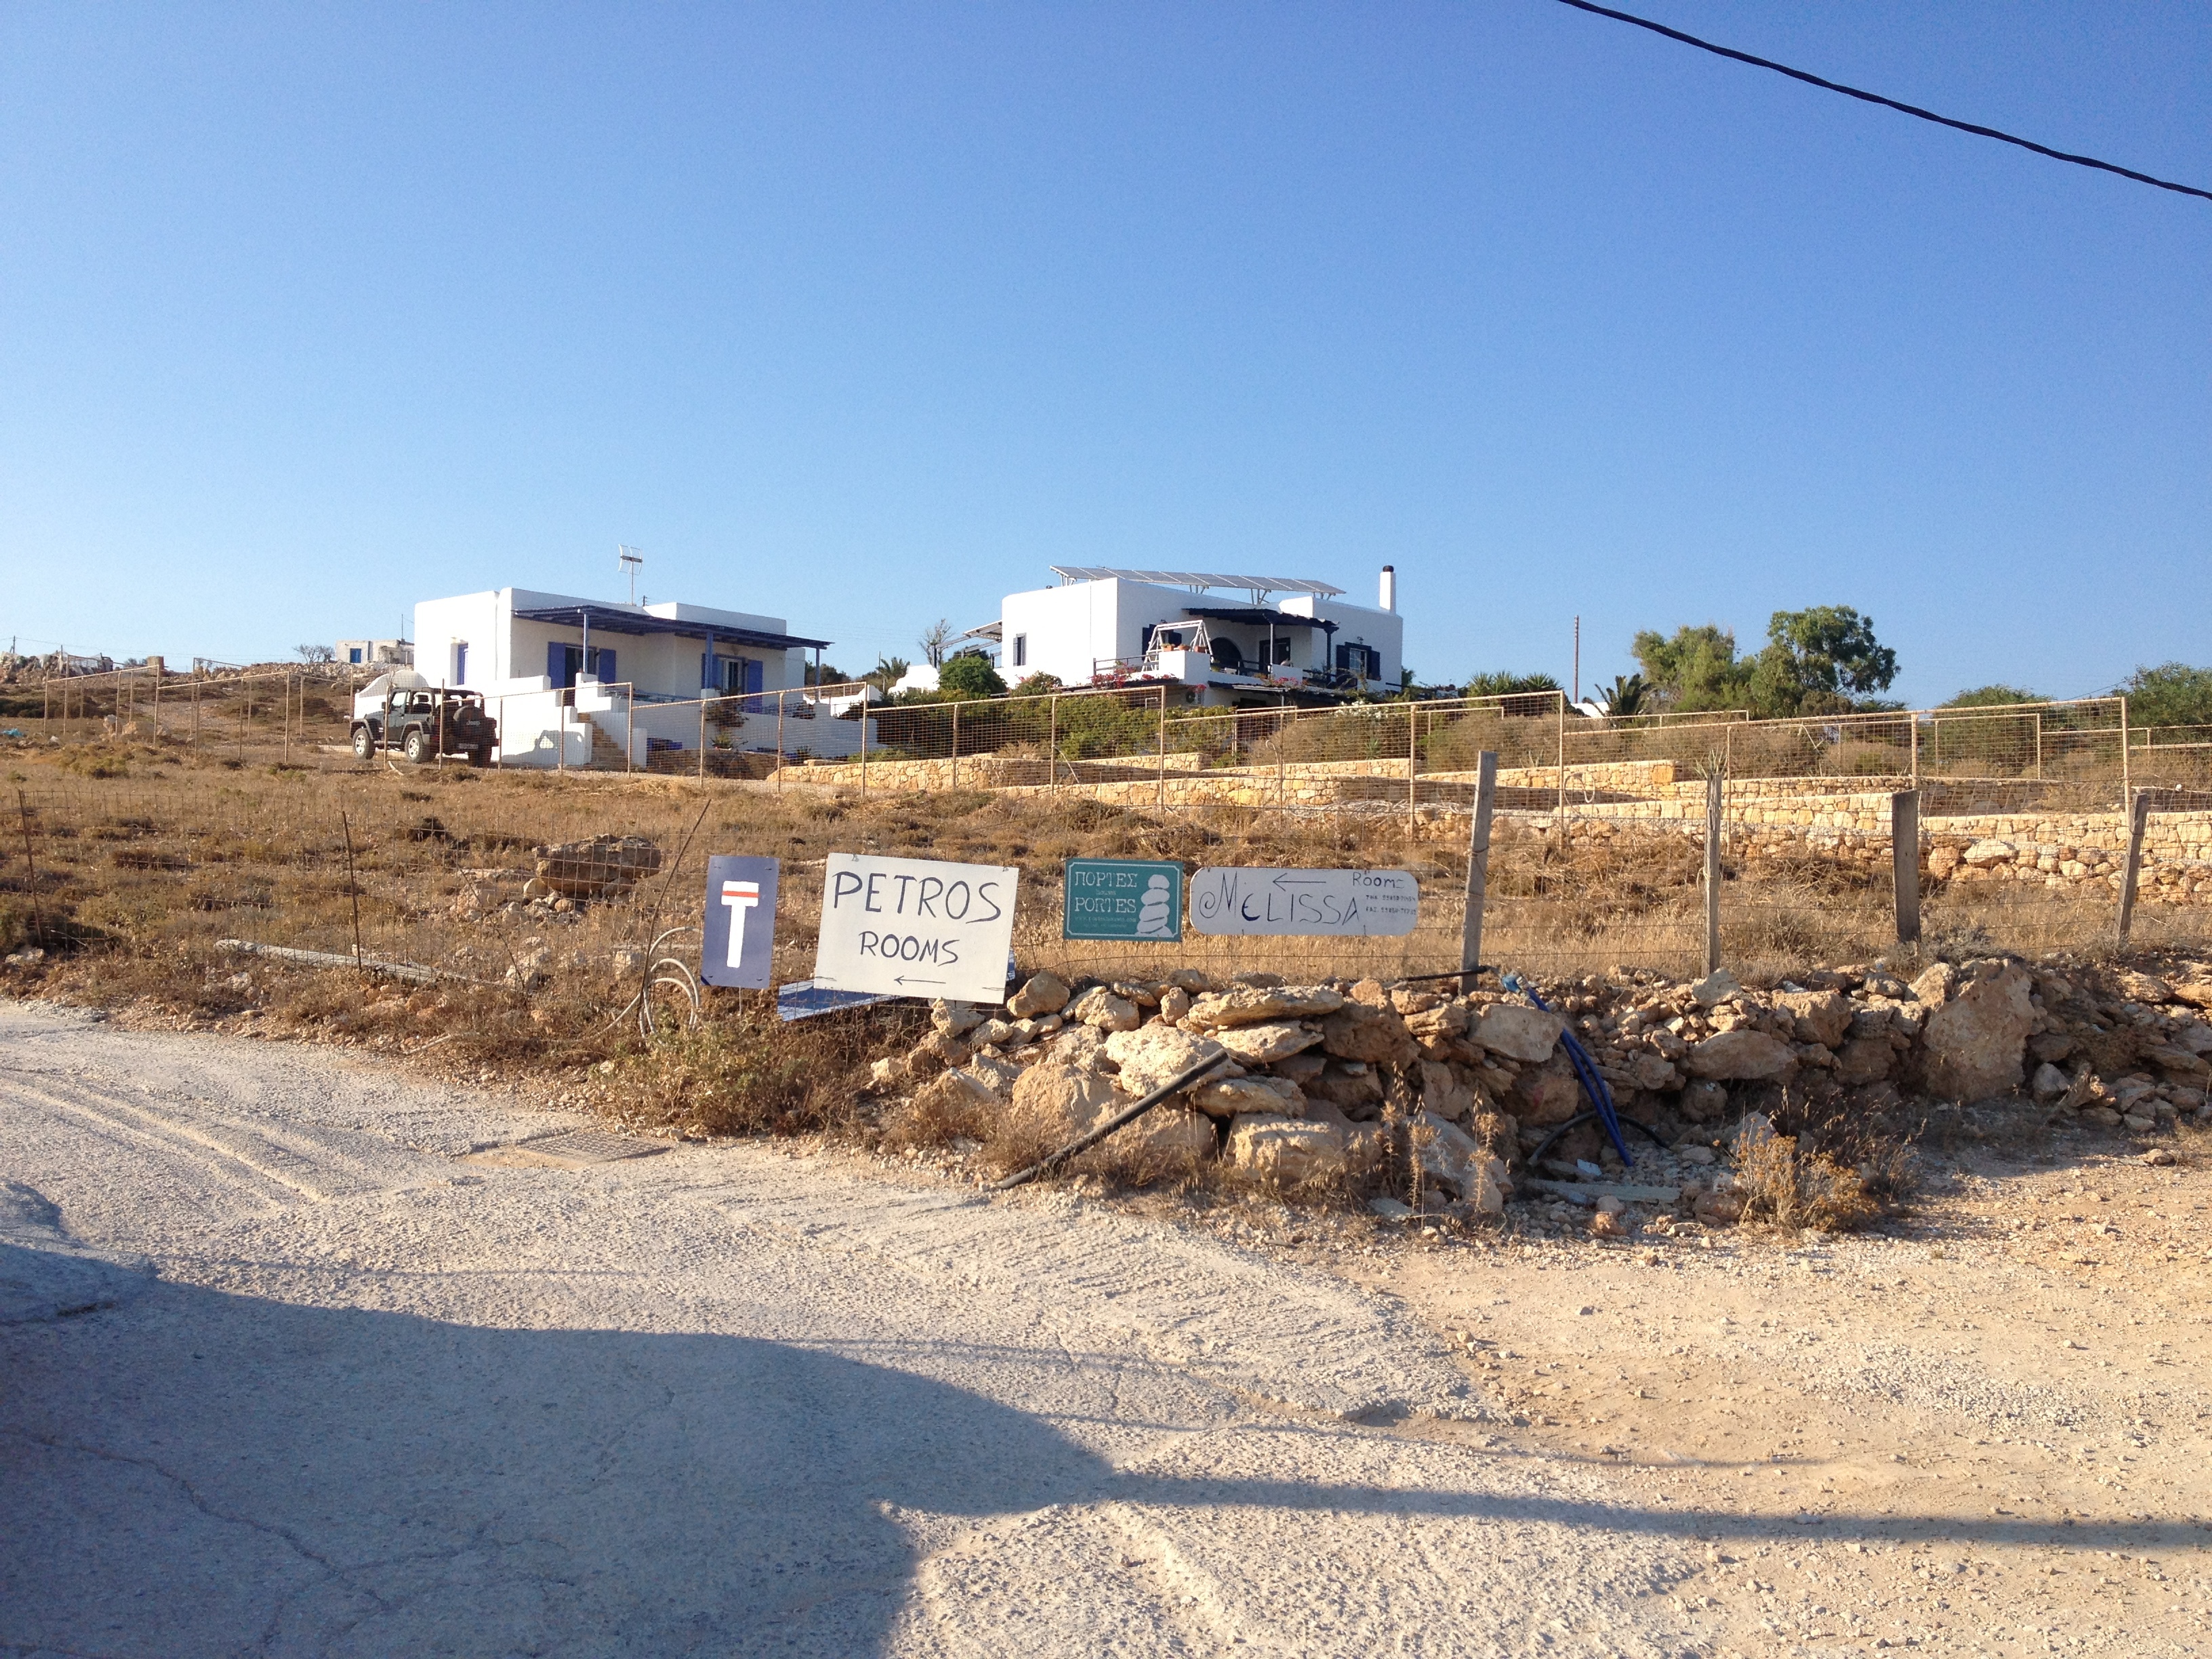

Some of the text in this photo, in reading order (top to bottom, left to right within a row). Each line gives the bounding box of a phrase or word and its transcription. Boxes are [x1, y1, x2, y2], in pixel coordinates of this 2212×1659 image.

[1074, 872, 1139, 888] ΠΟΡΤΕΣ
[832, 871, 1002, 924] PETROS
[1074, 897, 1137, 914] PORTES
[859, 930, 960, 967] ROOMS
